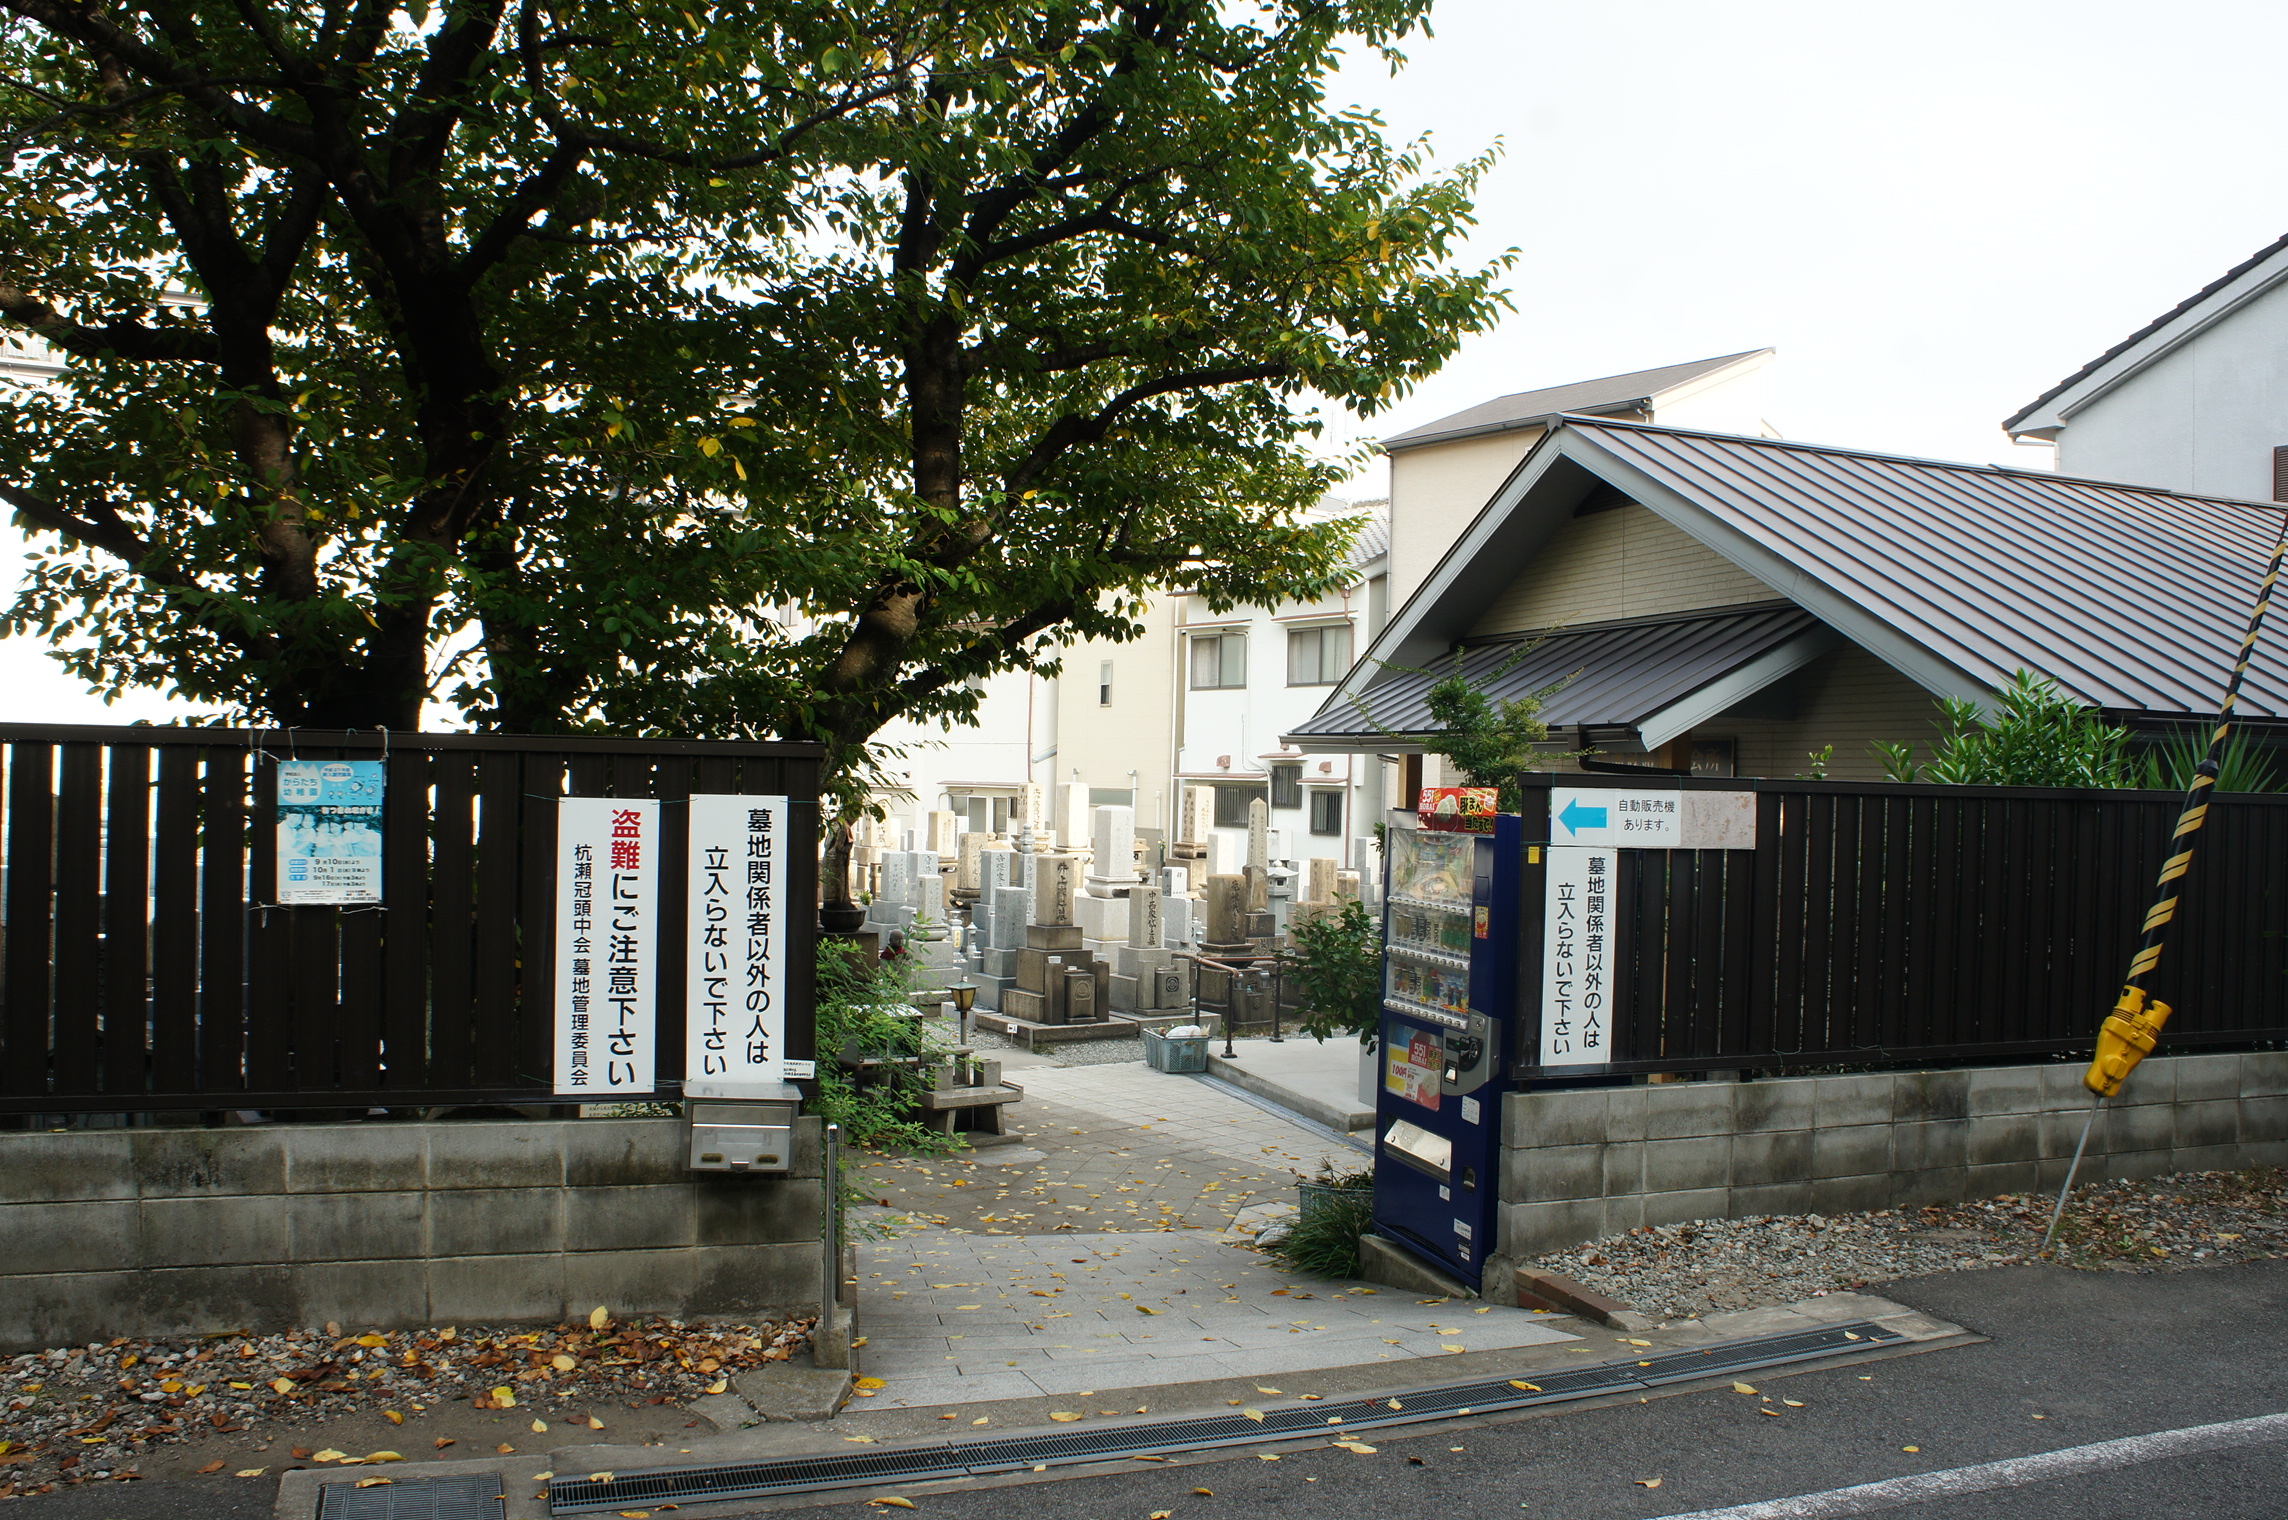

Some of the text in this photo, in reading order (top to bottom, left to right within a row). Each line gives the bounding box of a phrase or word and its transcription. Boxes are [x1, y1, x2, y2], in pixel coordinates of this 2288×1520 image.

[283, 778, 318, 787] からたち
[1422, 789, 1434, 803] 551
[1460, 796, 1483, 815] 豚まん
[1618, 800, 1675, 814] 自動販売機
[1624, 818, 1670, 832] あります。
[608, 809, 642, 1086] 盗難にご注意下さい
[703, 846, 729, 1076] 立入らないで下さい
[746, 808, 772, 1065] 墓地関係者以外の人は
[1553, 882, 1576, 1055] 立入らないで下さい
[1583, 856, 1606, 1049] 墓地関係者以外の人は
[570, 958, 591, 1087] 墓地管理委員会
[1414, 1042, 1426, 1058] 551
